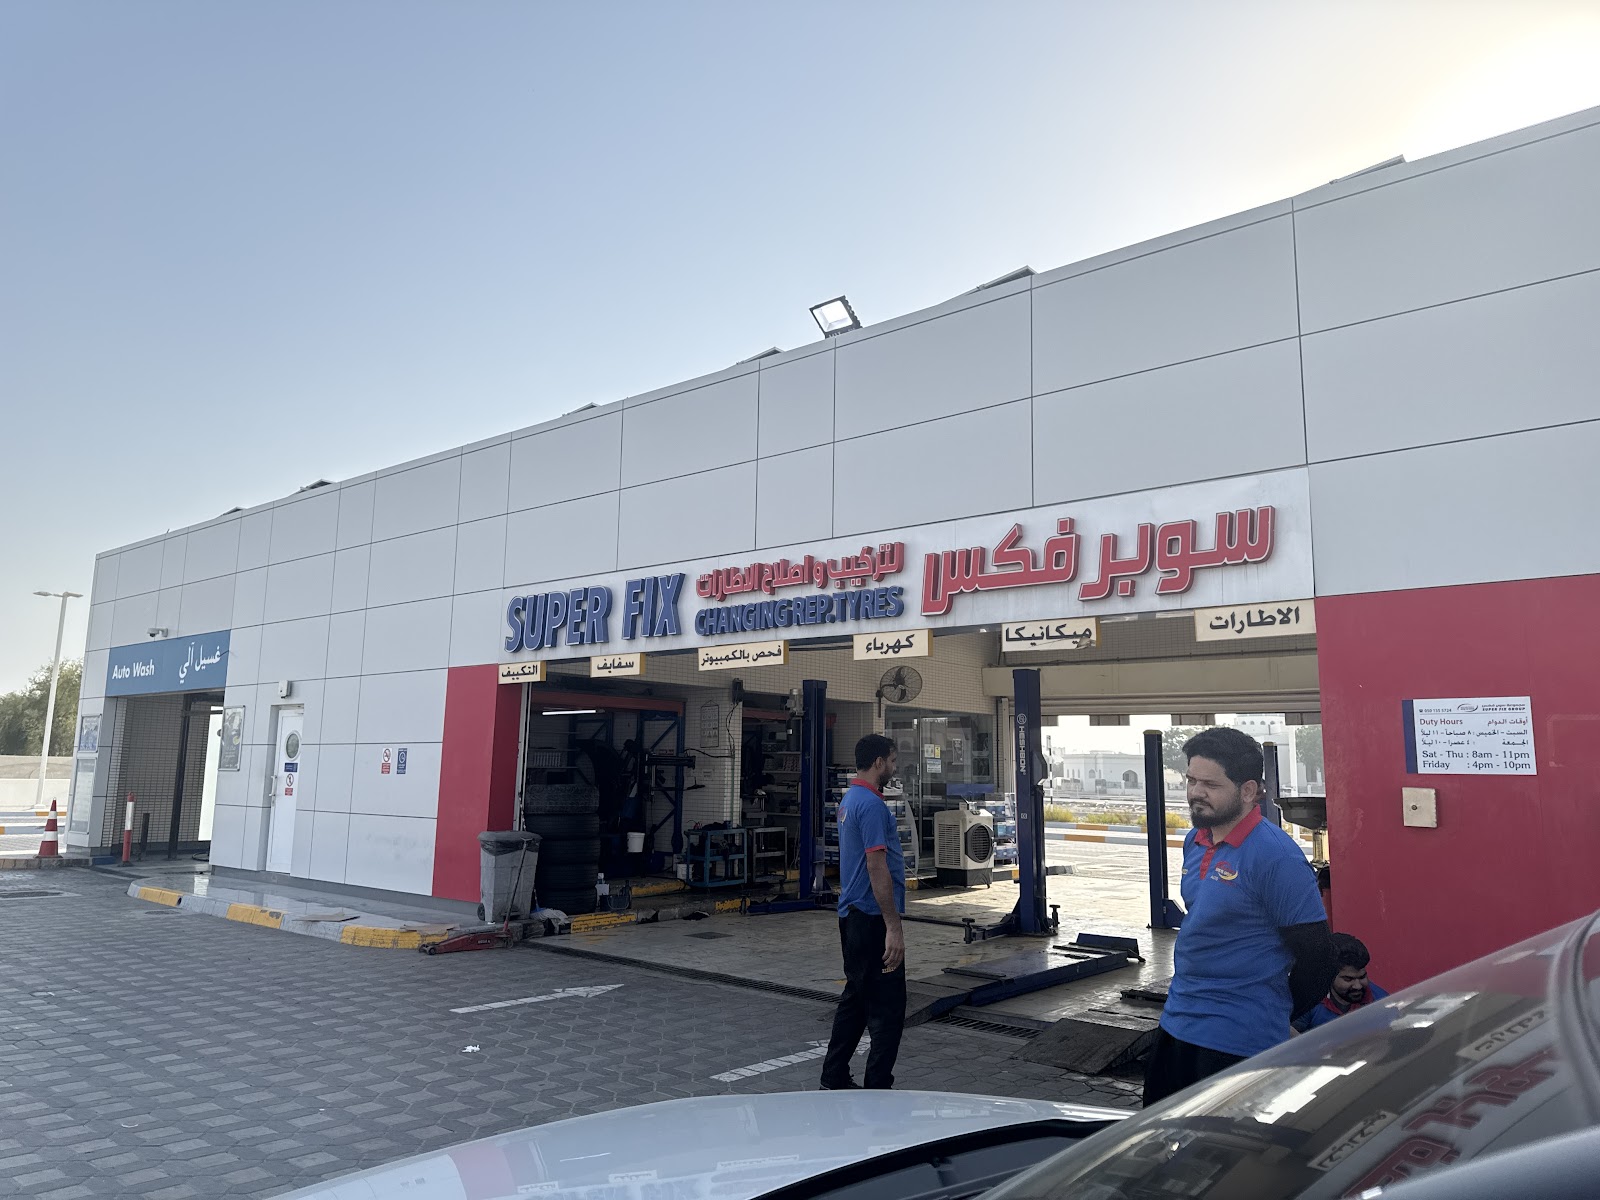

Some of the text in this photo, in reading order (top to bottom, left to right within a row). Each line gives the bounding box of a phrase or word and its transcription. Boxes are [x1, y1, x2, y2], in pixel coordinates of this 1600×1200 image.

[827, 542, 904, 589] لتركيب
[920, 505, 1277, 617] سوبر فكس
[696, 562, 765, 602] الاطارات
[504, 573, 687, 653] SUPER FIX
[694, 597, 793, 636] CHANGING
[1209, 606, 1301, 634] الاطارات
[865, 633, 915, 655] كهرباء
[1005, 623, 1093, 646] ميكانيكا
[178, 641, 221, 684] غسيل آلي
[700, 645, 782, 666] فحص بالكمبيوتر
[112, 659, 155, 680] Auto Wash
[501, 664, 538, 680] التكييف
[1420, 718, 1438, 727] Duty
[1423, 760, 1450, 770] Friday
[1472, 761, 1493, 770] 4pm
[1503, 761, 1531, 771] 10pm
[1502, 751, 1530, 760] 11pm
